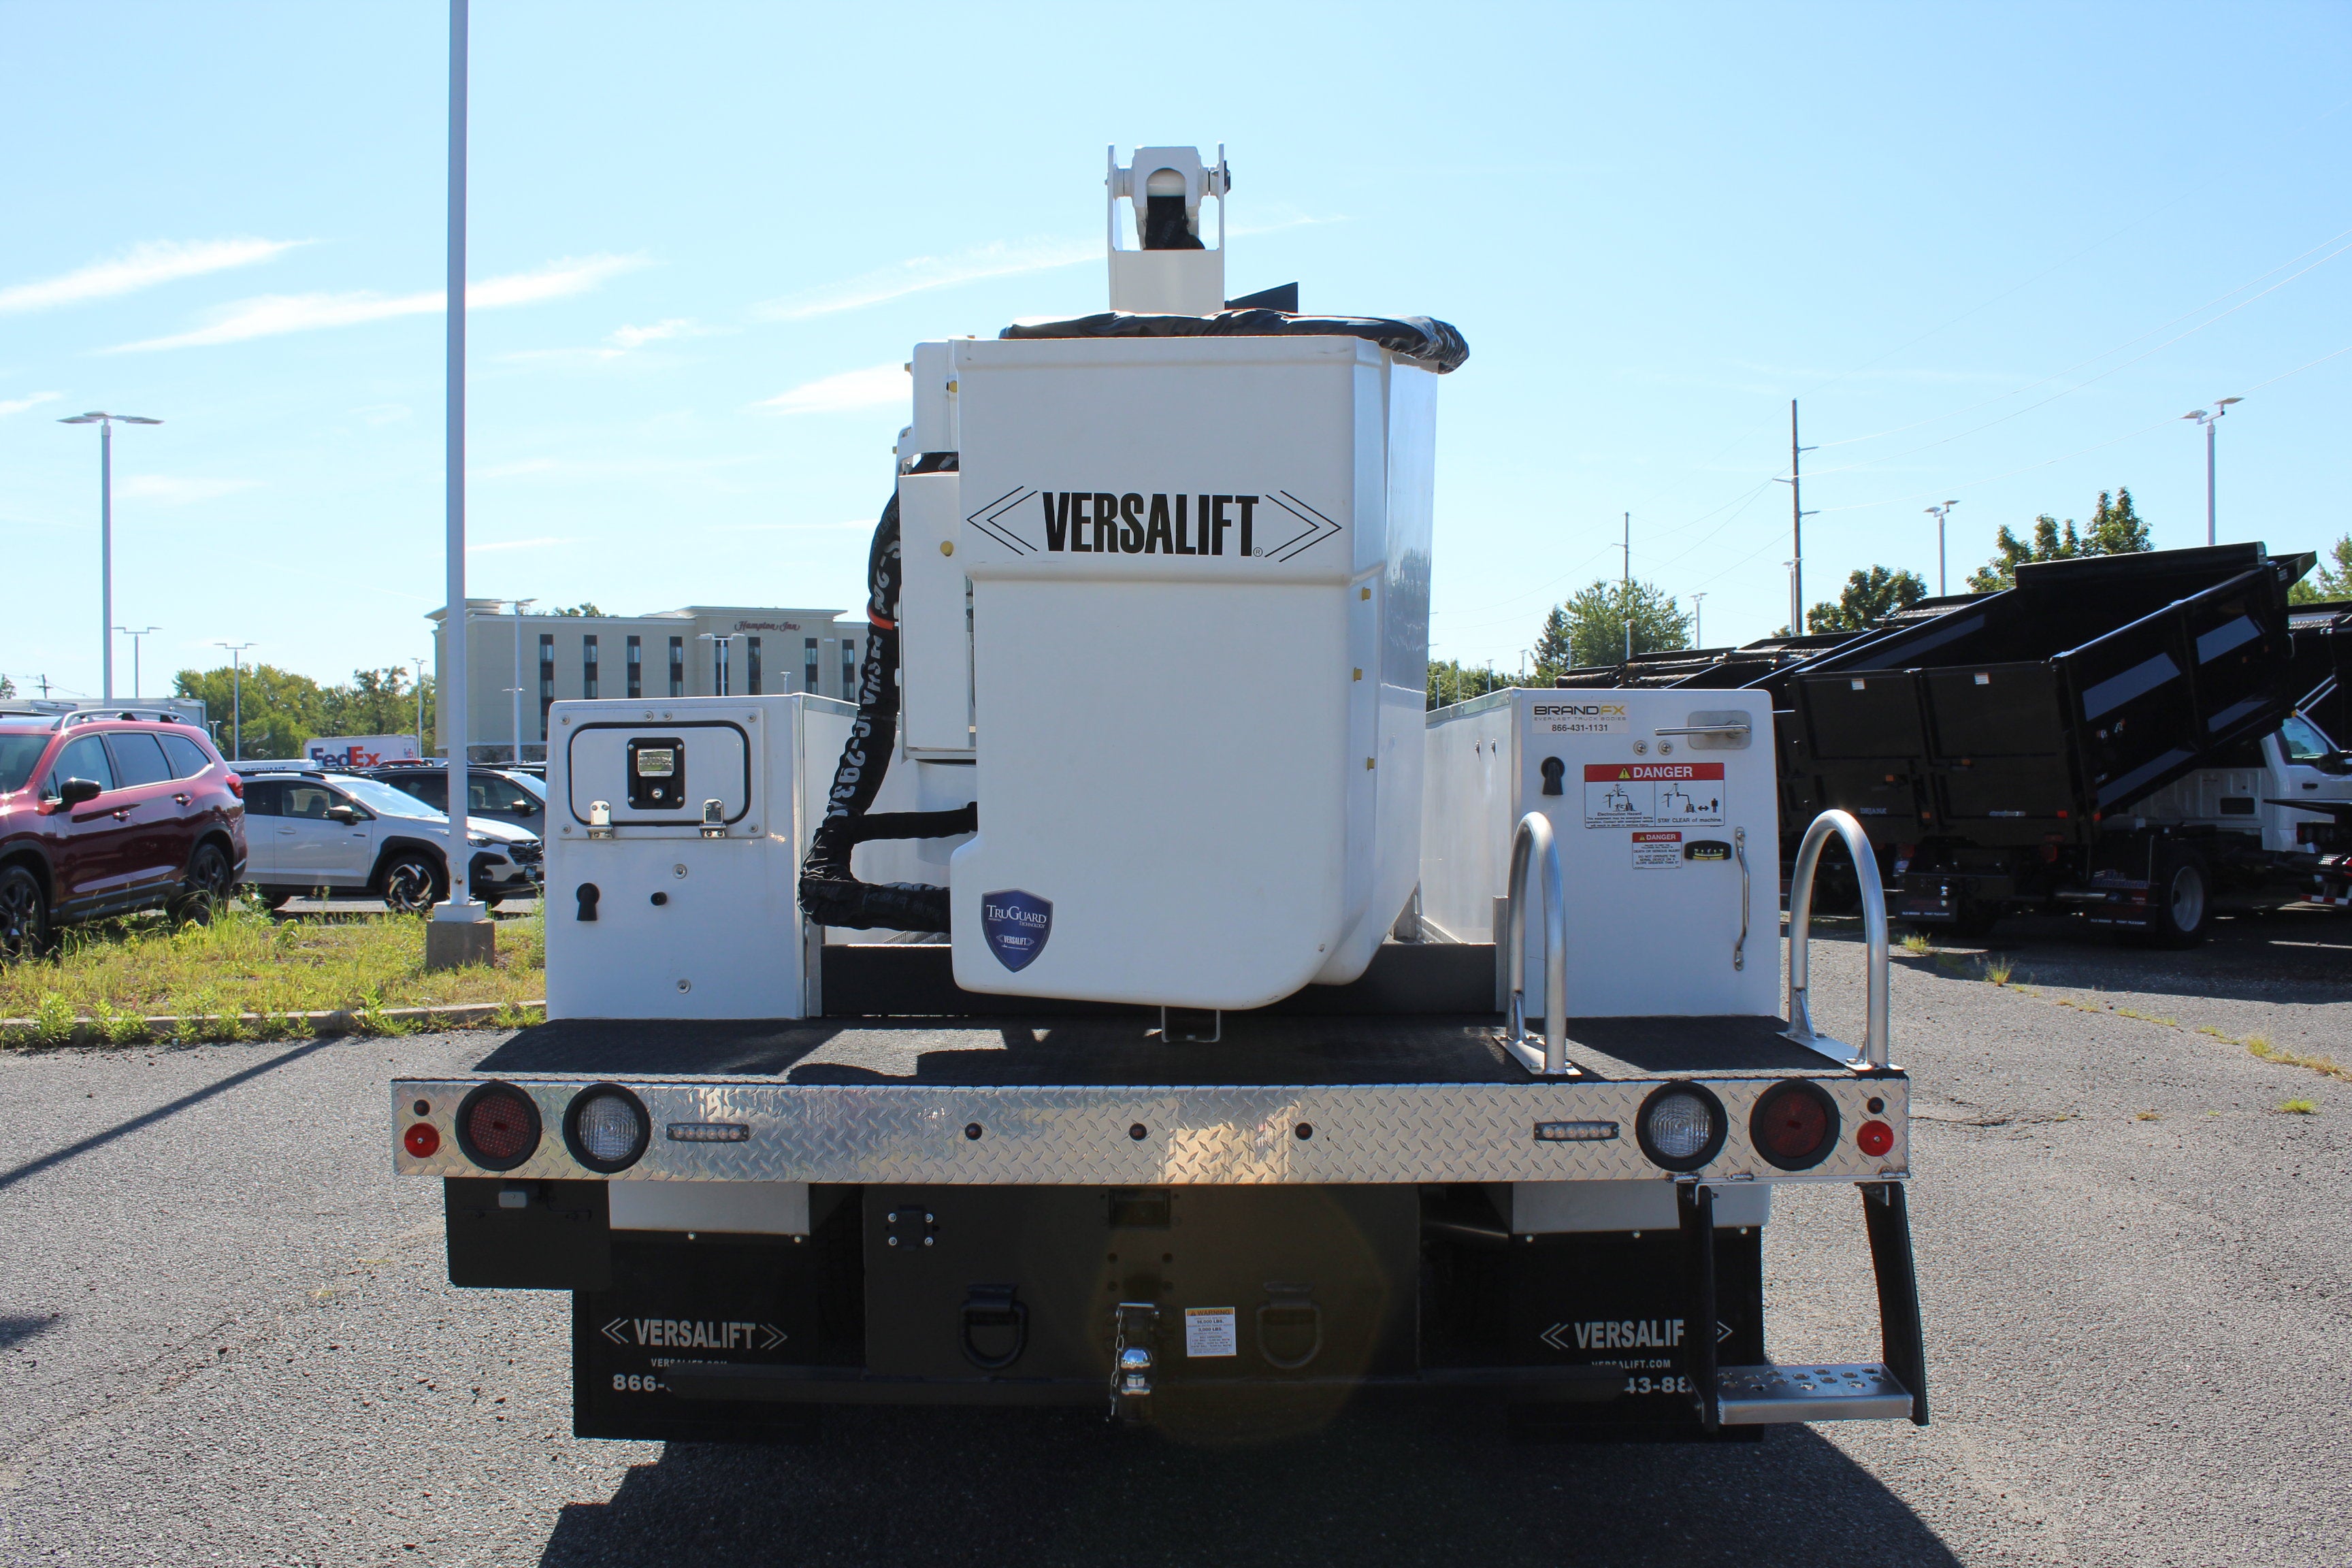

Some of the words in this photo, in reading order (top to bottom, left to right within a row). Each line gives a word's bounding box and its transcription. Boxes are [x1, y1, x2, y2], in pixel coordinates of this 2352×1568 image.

[1043, 491, 1259, 557] VERSALIFT
[734, 621, 779, 632] Hampton
[779, 621, 800, 632] Inn
[311, 746, 381, 768] FedEx
[1633, 766, 1693, 779] DANGER
[1019, 921, 1045, 929] TECHNOLOGY
[1004, 935, 1027, 946] VERSALIFT
[634, 1318, 756, 1350] VERSALIFT
[1574, 1319, 1685, 1350] VERSALIF
[612, 1373, 672, 1393] 866-
